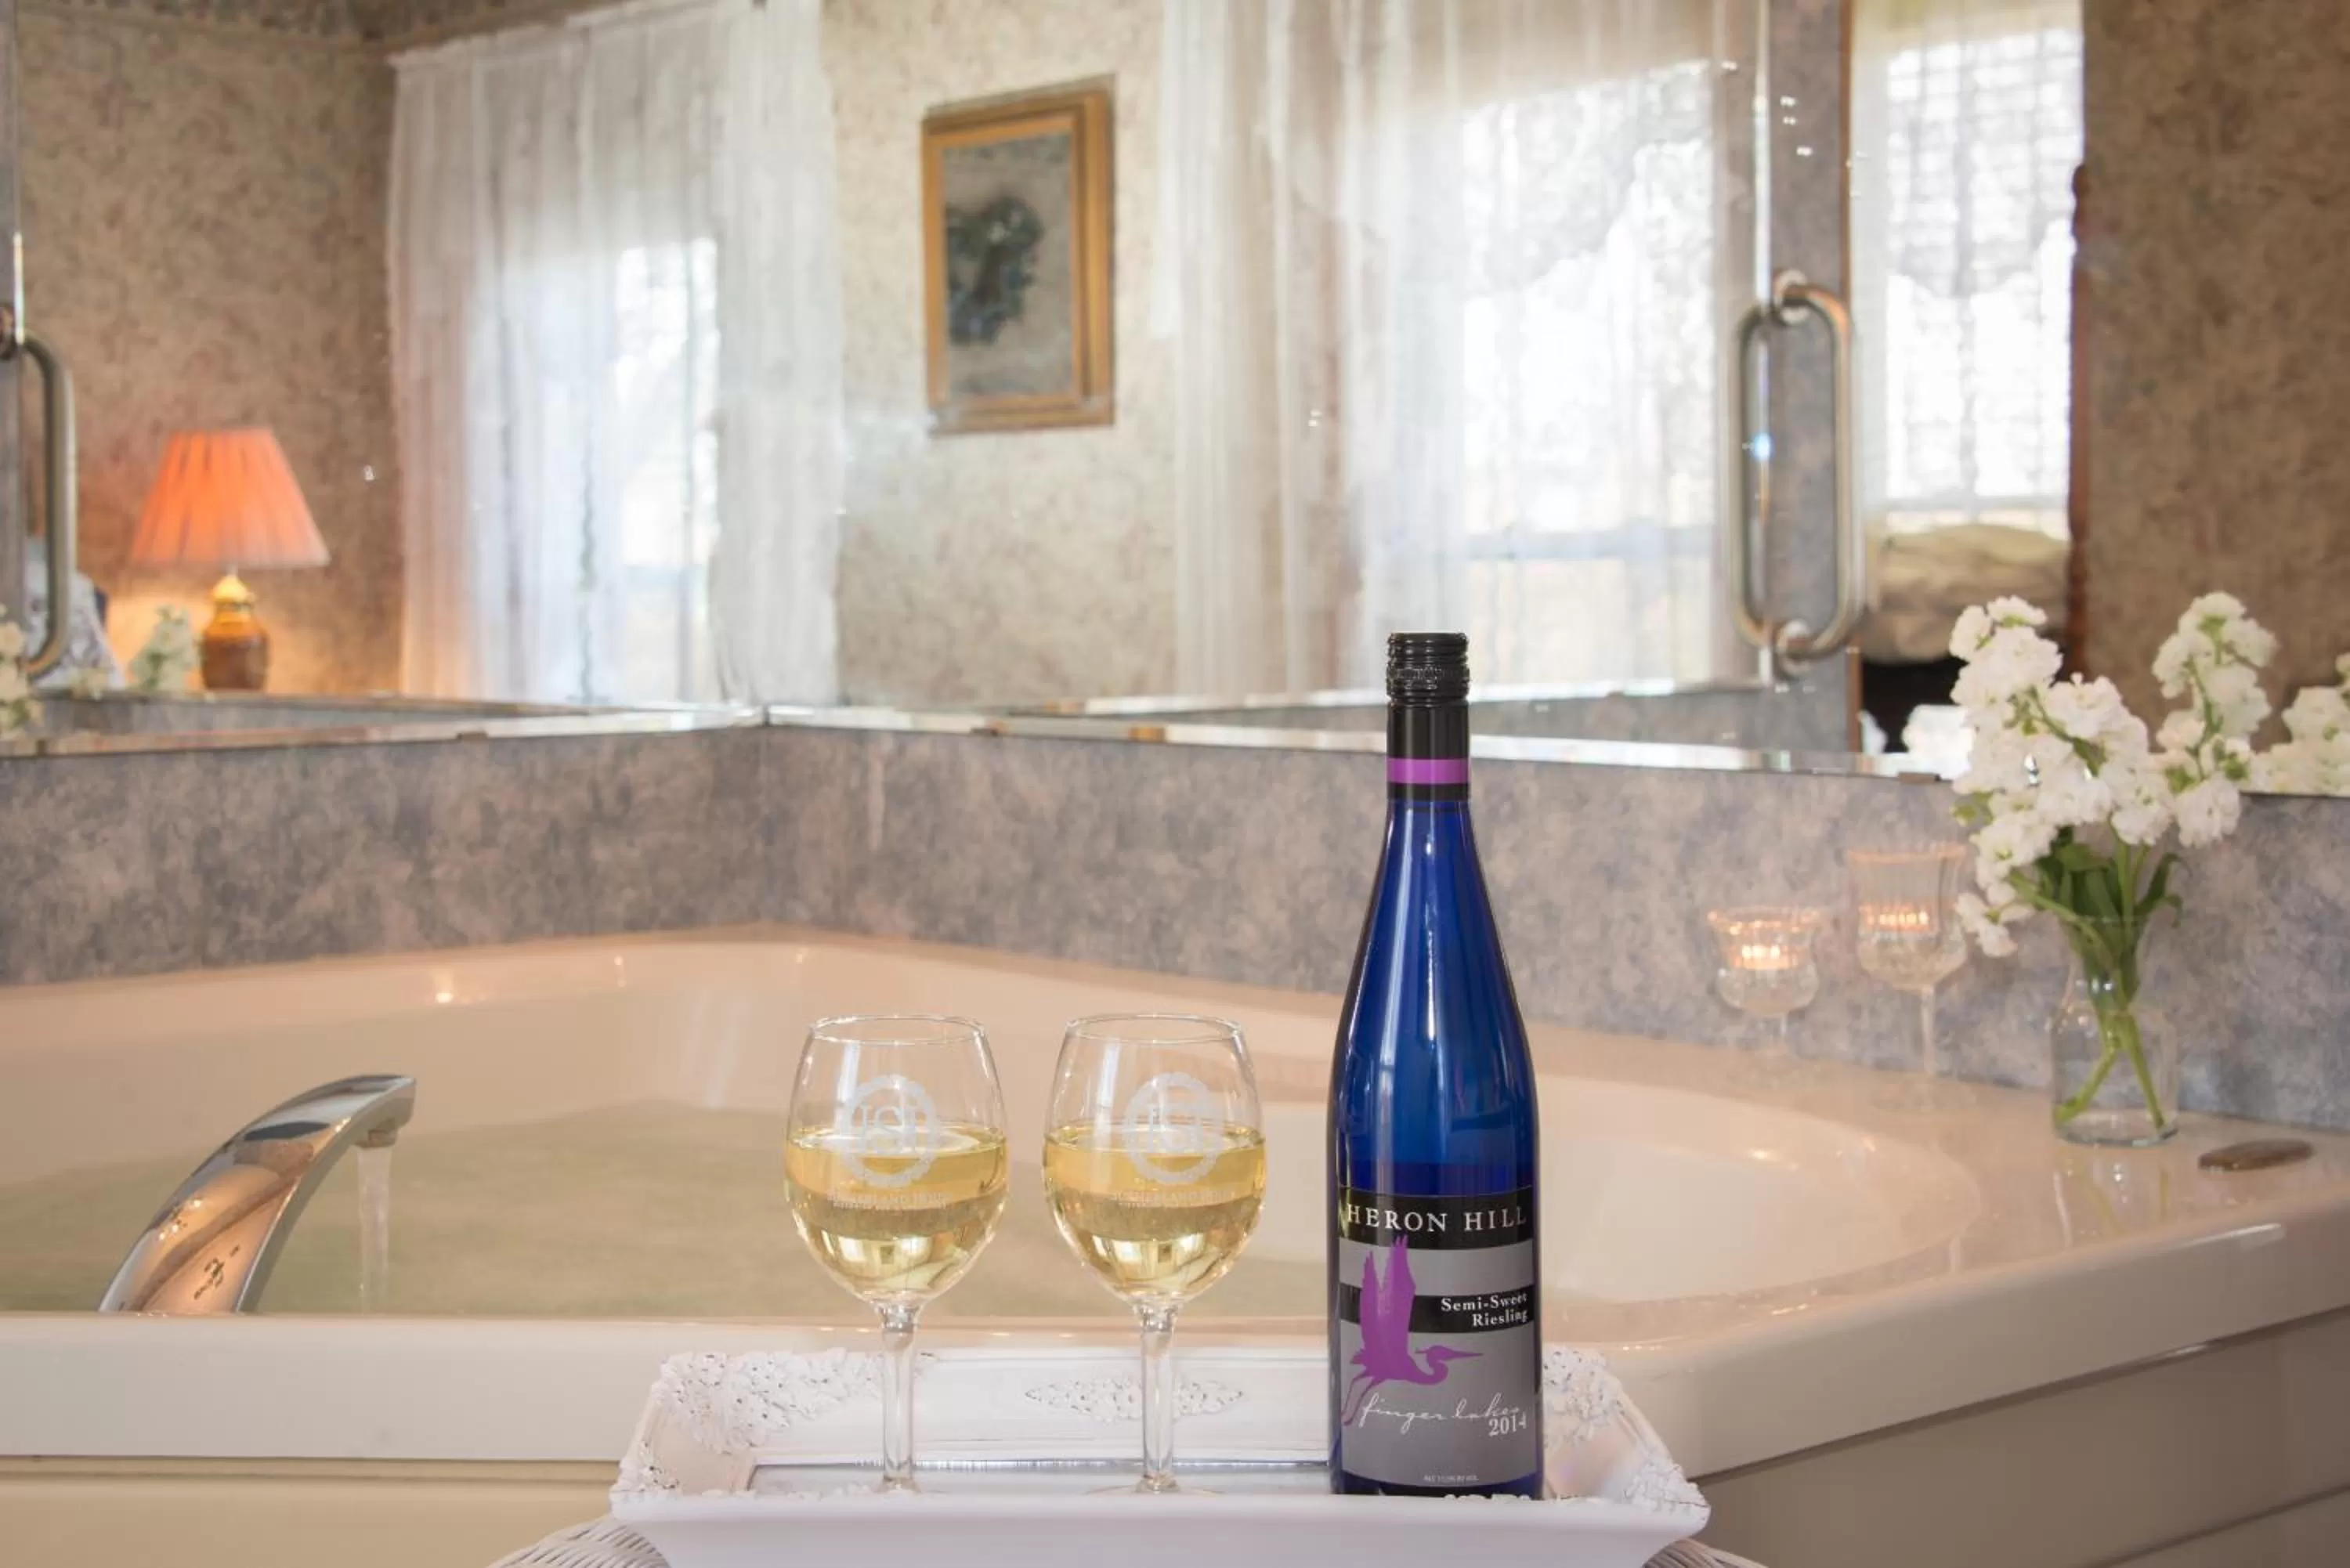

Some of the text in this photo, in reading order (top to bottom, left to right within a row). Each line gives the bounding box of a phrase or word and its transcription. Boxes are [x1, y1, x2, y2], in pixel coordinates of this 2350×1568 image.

[1347, 1203, 1527, 1232] HERON HILL
[1441, 1293, 1528, 1312] Semi-Sweet
[1472, 1308, 1528, 1327] Riesling
[1488, 1411, 1528, 1437] 2014
